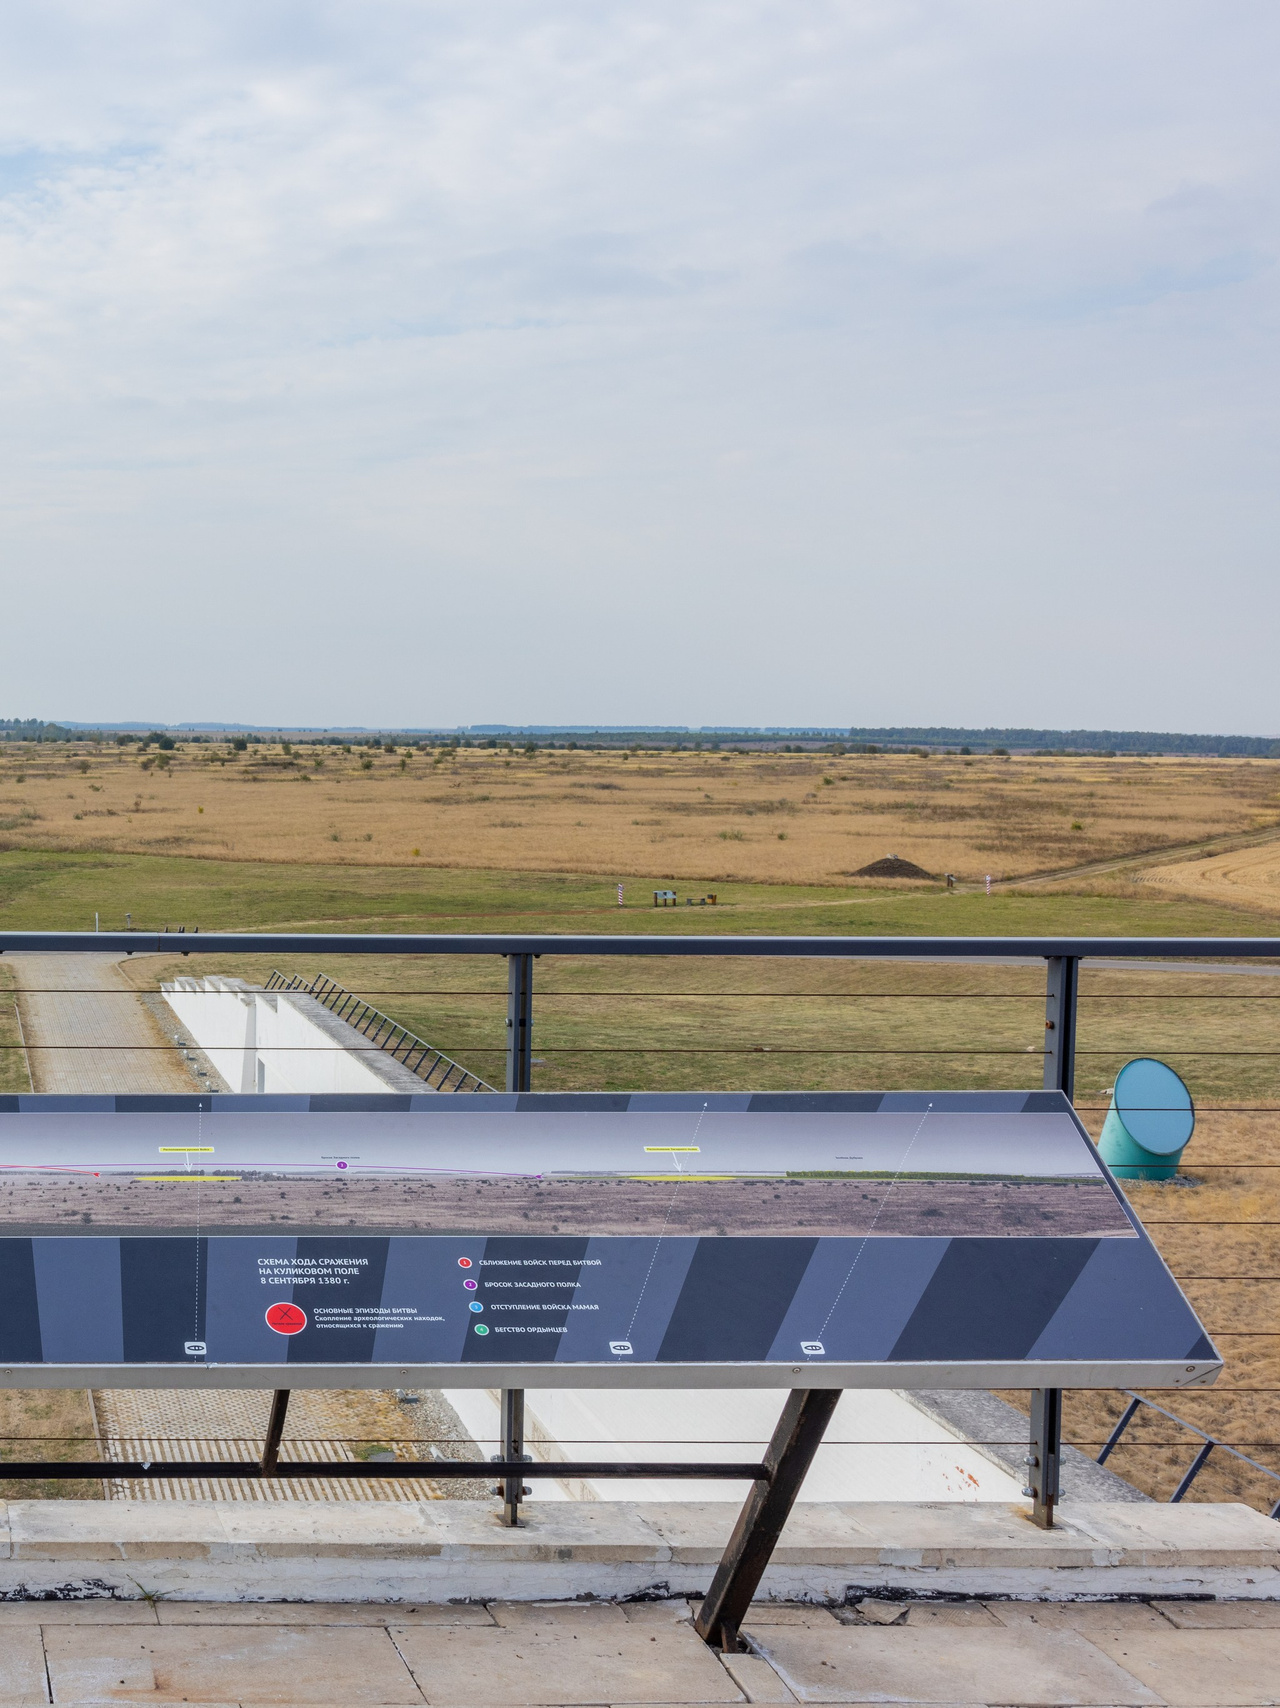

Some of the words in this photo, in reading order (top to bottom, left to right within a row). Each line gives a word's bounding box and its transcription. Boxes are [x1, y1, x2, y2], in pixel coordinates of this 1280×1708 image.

[257, 1258, 290, 1266] СХЕМА
[290, 1258, 318, 1267] ХОДА
[318, 1258, 369, 1266] СРАЖЕНИЯ
[548, 1259, 572, 1267] ПЕРЕД
[258, 1267, 273, 1275] НА
[273, 1267, 332, 1275] КУЛИКОВОМ
[334, 1267, 360, 1275] ПОЛЕ
[260, 1277, 267, 1285] 8
[268, 1277, 316, 1285] СЕНТЯБРЯ
[317, 1277, 341, 1285] 1380
[354, 1307, 391, 1315] ЭПИЗОДЫ
[526, 1326, 568, 1334] ОРДЫНЦЕВ
